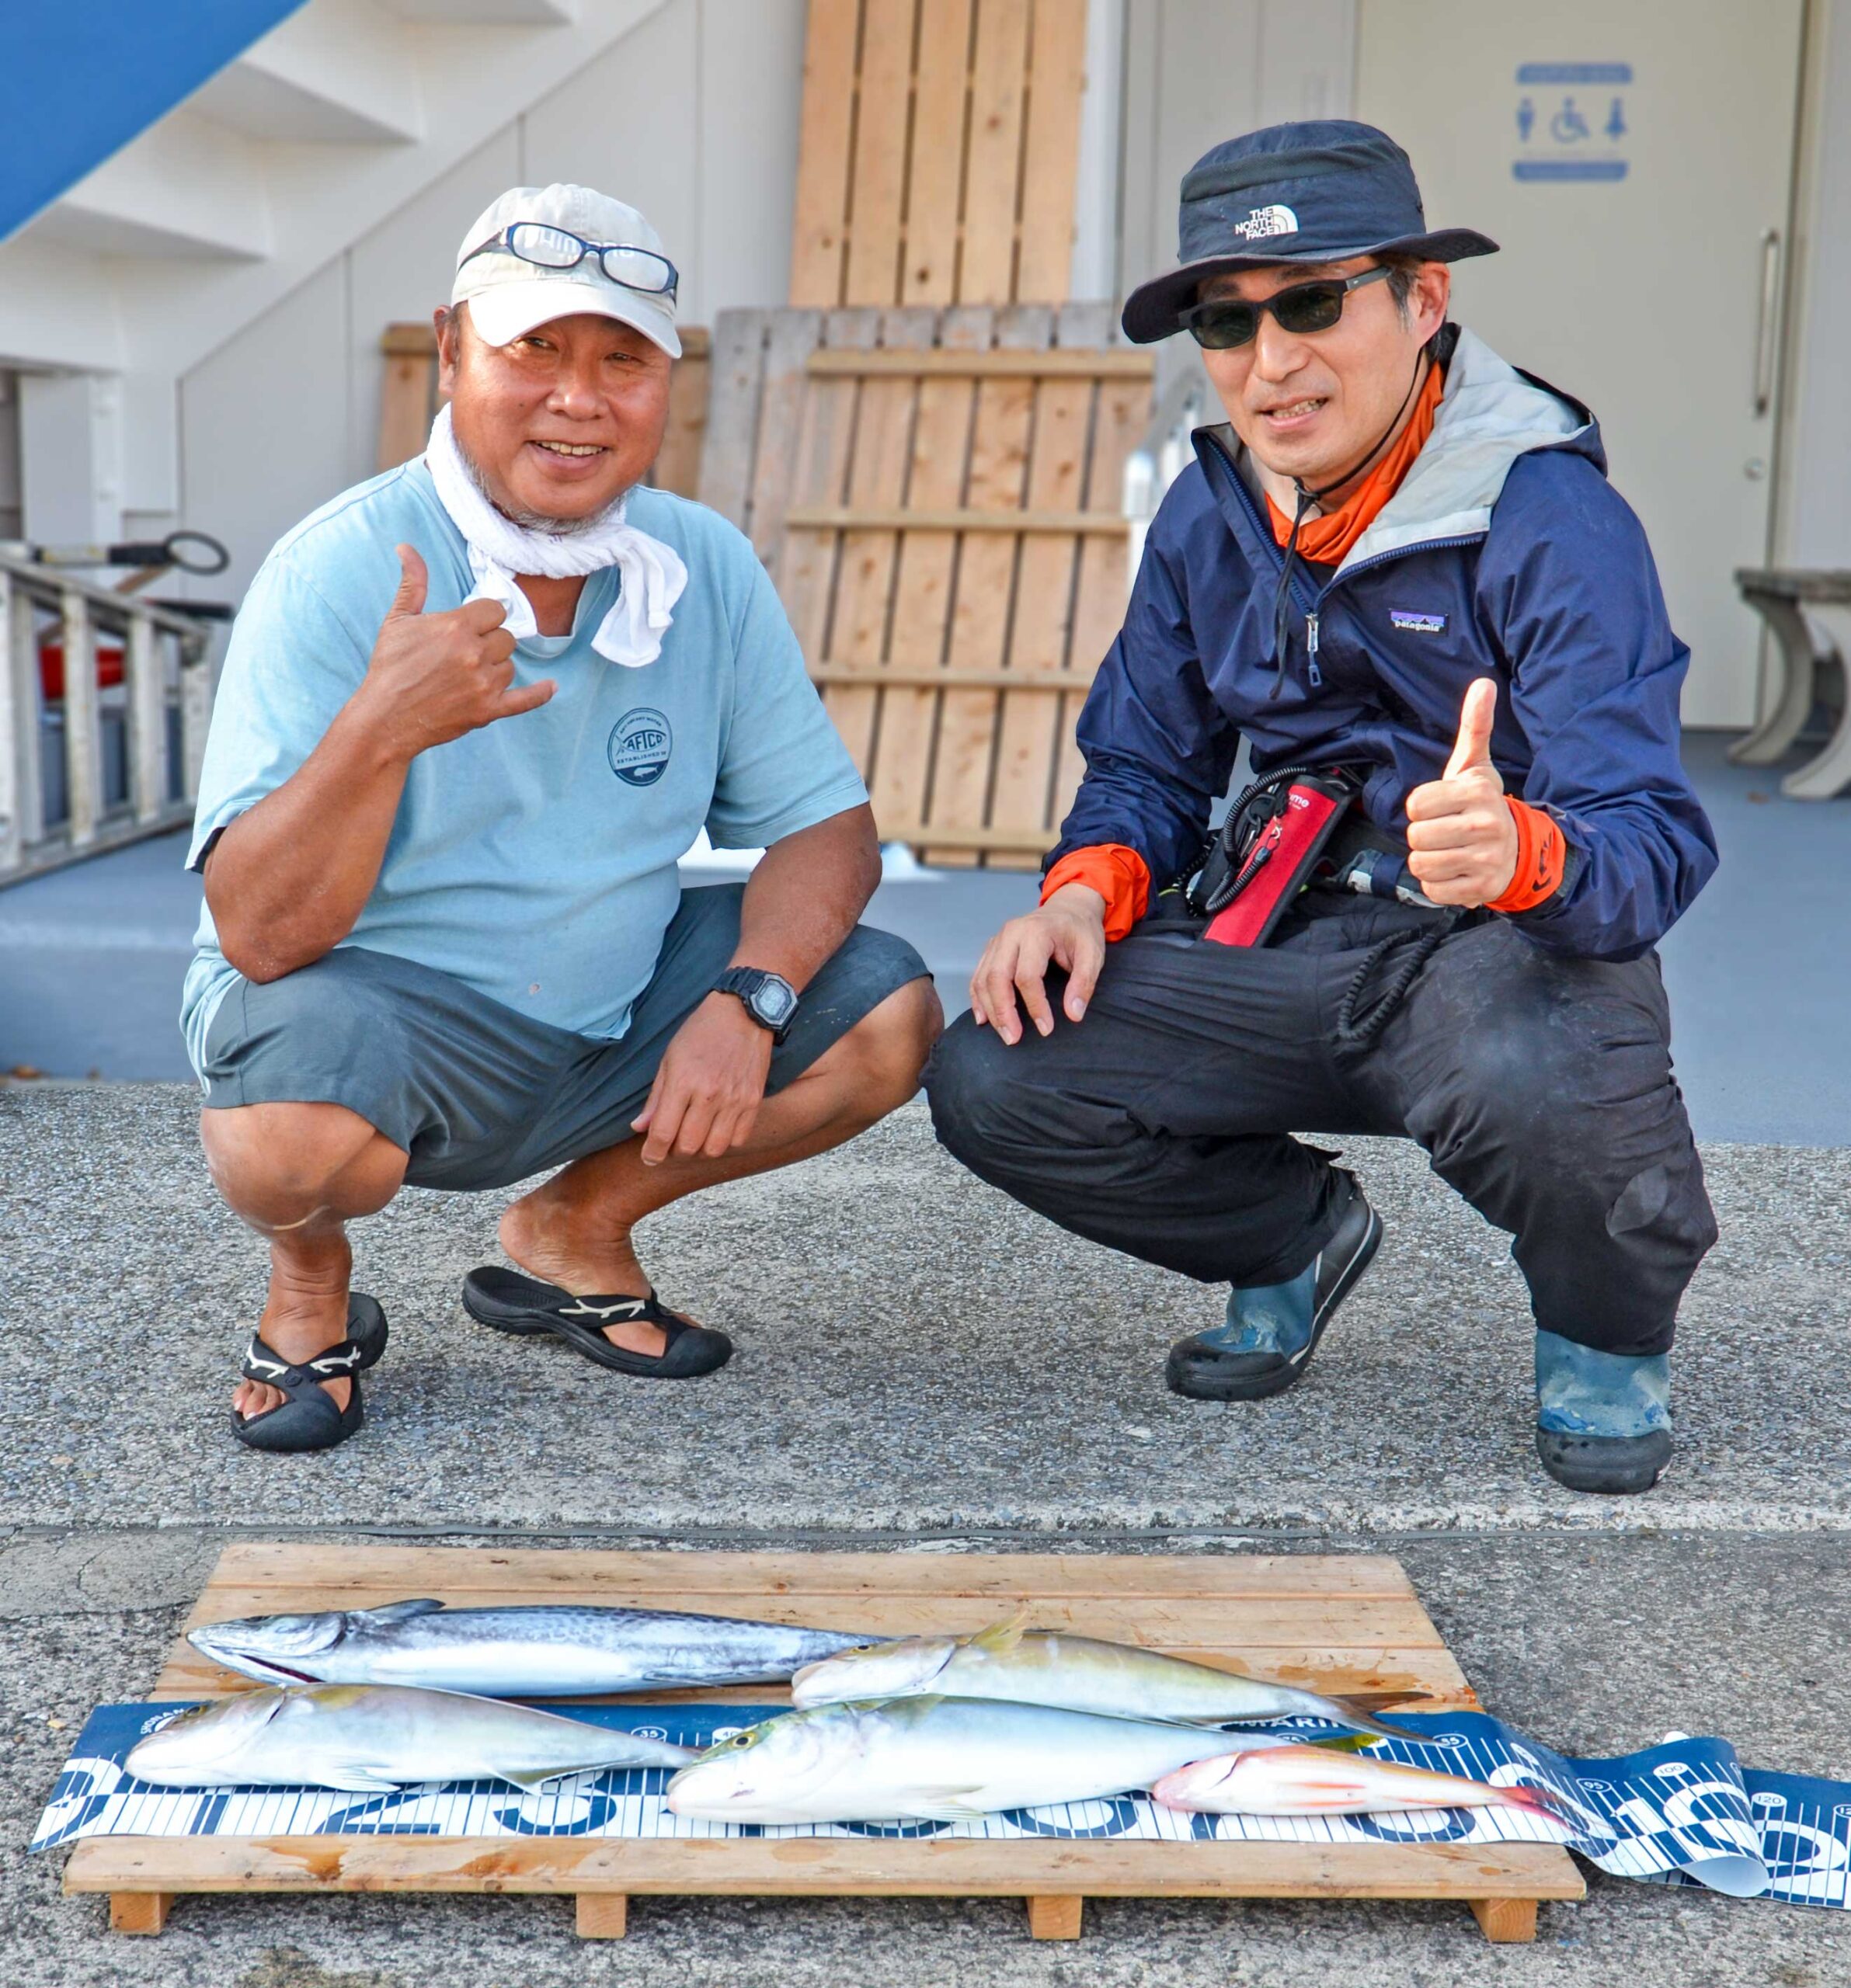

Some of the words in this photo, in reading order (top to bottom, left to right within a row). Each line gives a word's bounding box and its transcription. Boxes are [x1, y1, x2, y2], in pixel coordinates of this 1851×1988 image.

[1249, 207, 1274, 219] THE
[1235, 217, 1273, 235] NORTH
[1246, 226, 1275, 241] FACE
[1394, 620, 1439, 632] patagonia
[1658, 1764, 1683, 1774] 100
[1757, 1795, 1782, 1804] 120
